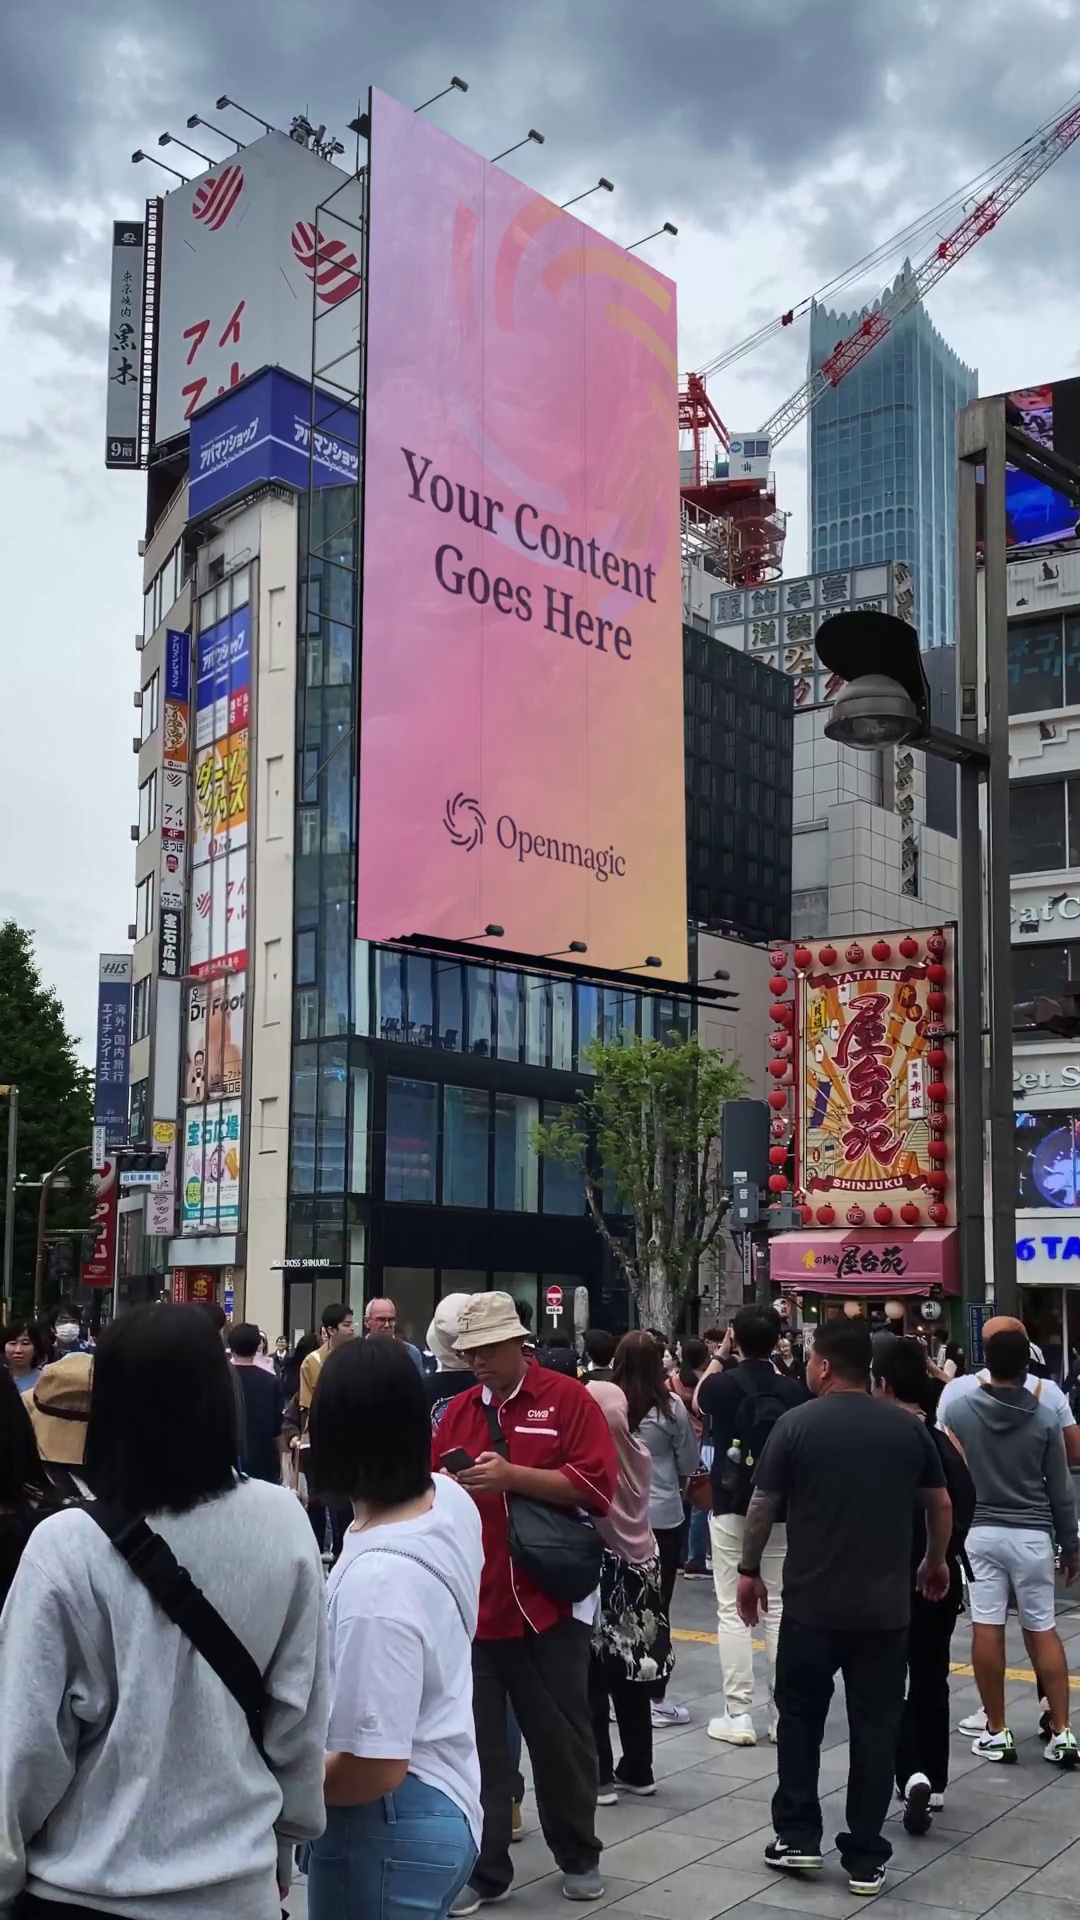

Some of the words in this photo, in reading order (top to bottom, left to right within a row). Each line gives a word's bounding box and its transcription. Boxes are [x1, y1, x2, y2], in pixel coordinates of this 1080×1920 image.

[110, 323, 138, 386] 黒木
[200, 415, 259, 471] アパマンショップ
[401, 446, 504, 536] Your
[514, 503, 658, 603] Content
[435, 544, 534, 622] Goes
[543, 585, 633, 661] Here
[167, 829, 179, 837] 4F
[496, 815, 626, 883] Openmagic
[162, 913, 177, 976] 宝石広場
[102, 963, 129, 974] HIS
[833, 970, 902, 985] YATAIEN
[190, 1004, 207, 1022] Dr
[212, 991, 246, 1017] Foot
[831, 991, 908, 1167] 屋台苑
[832, 1178, 903, 1191] SHINJUKU
[282, 1259, 300, 1268] CROSS
[302, 1258, 330, 1268] SHINJUKU
[835, 1245, 909, 1279] 屋台苑
